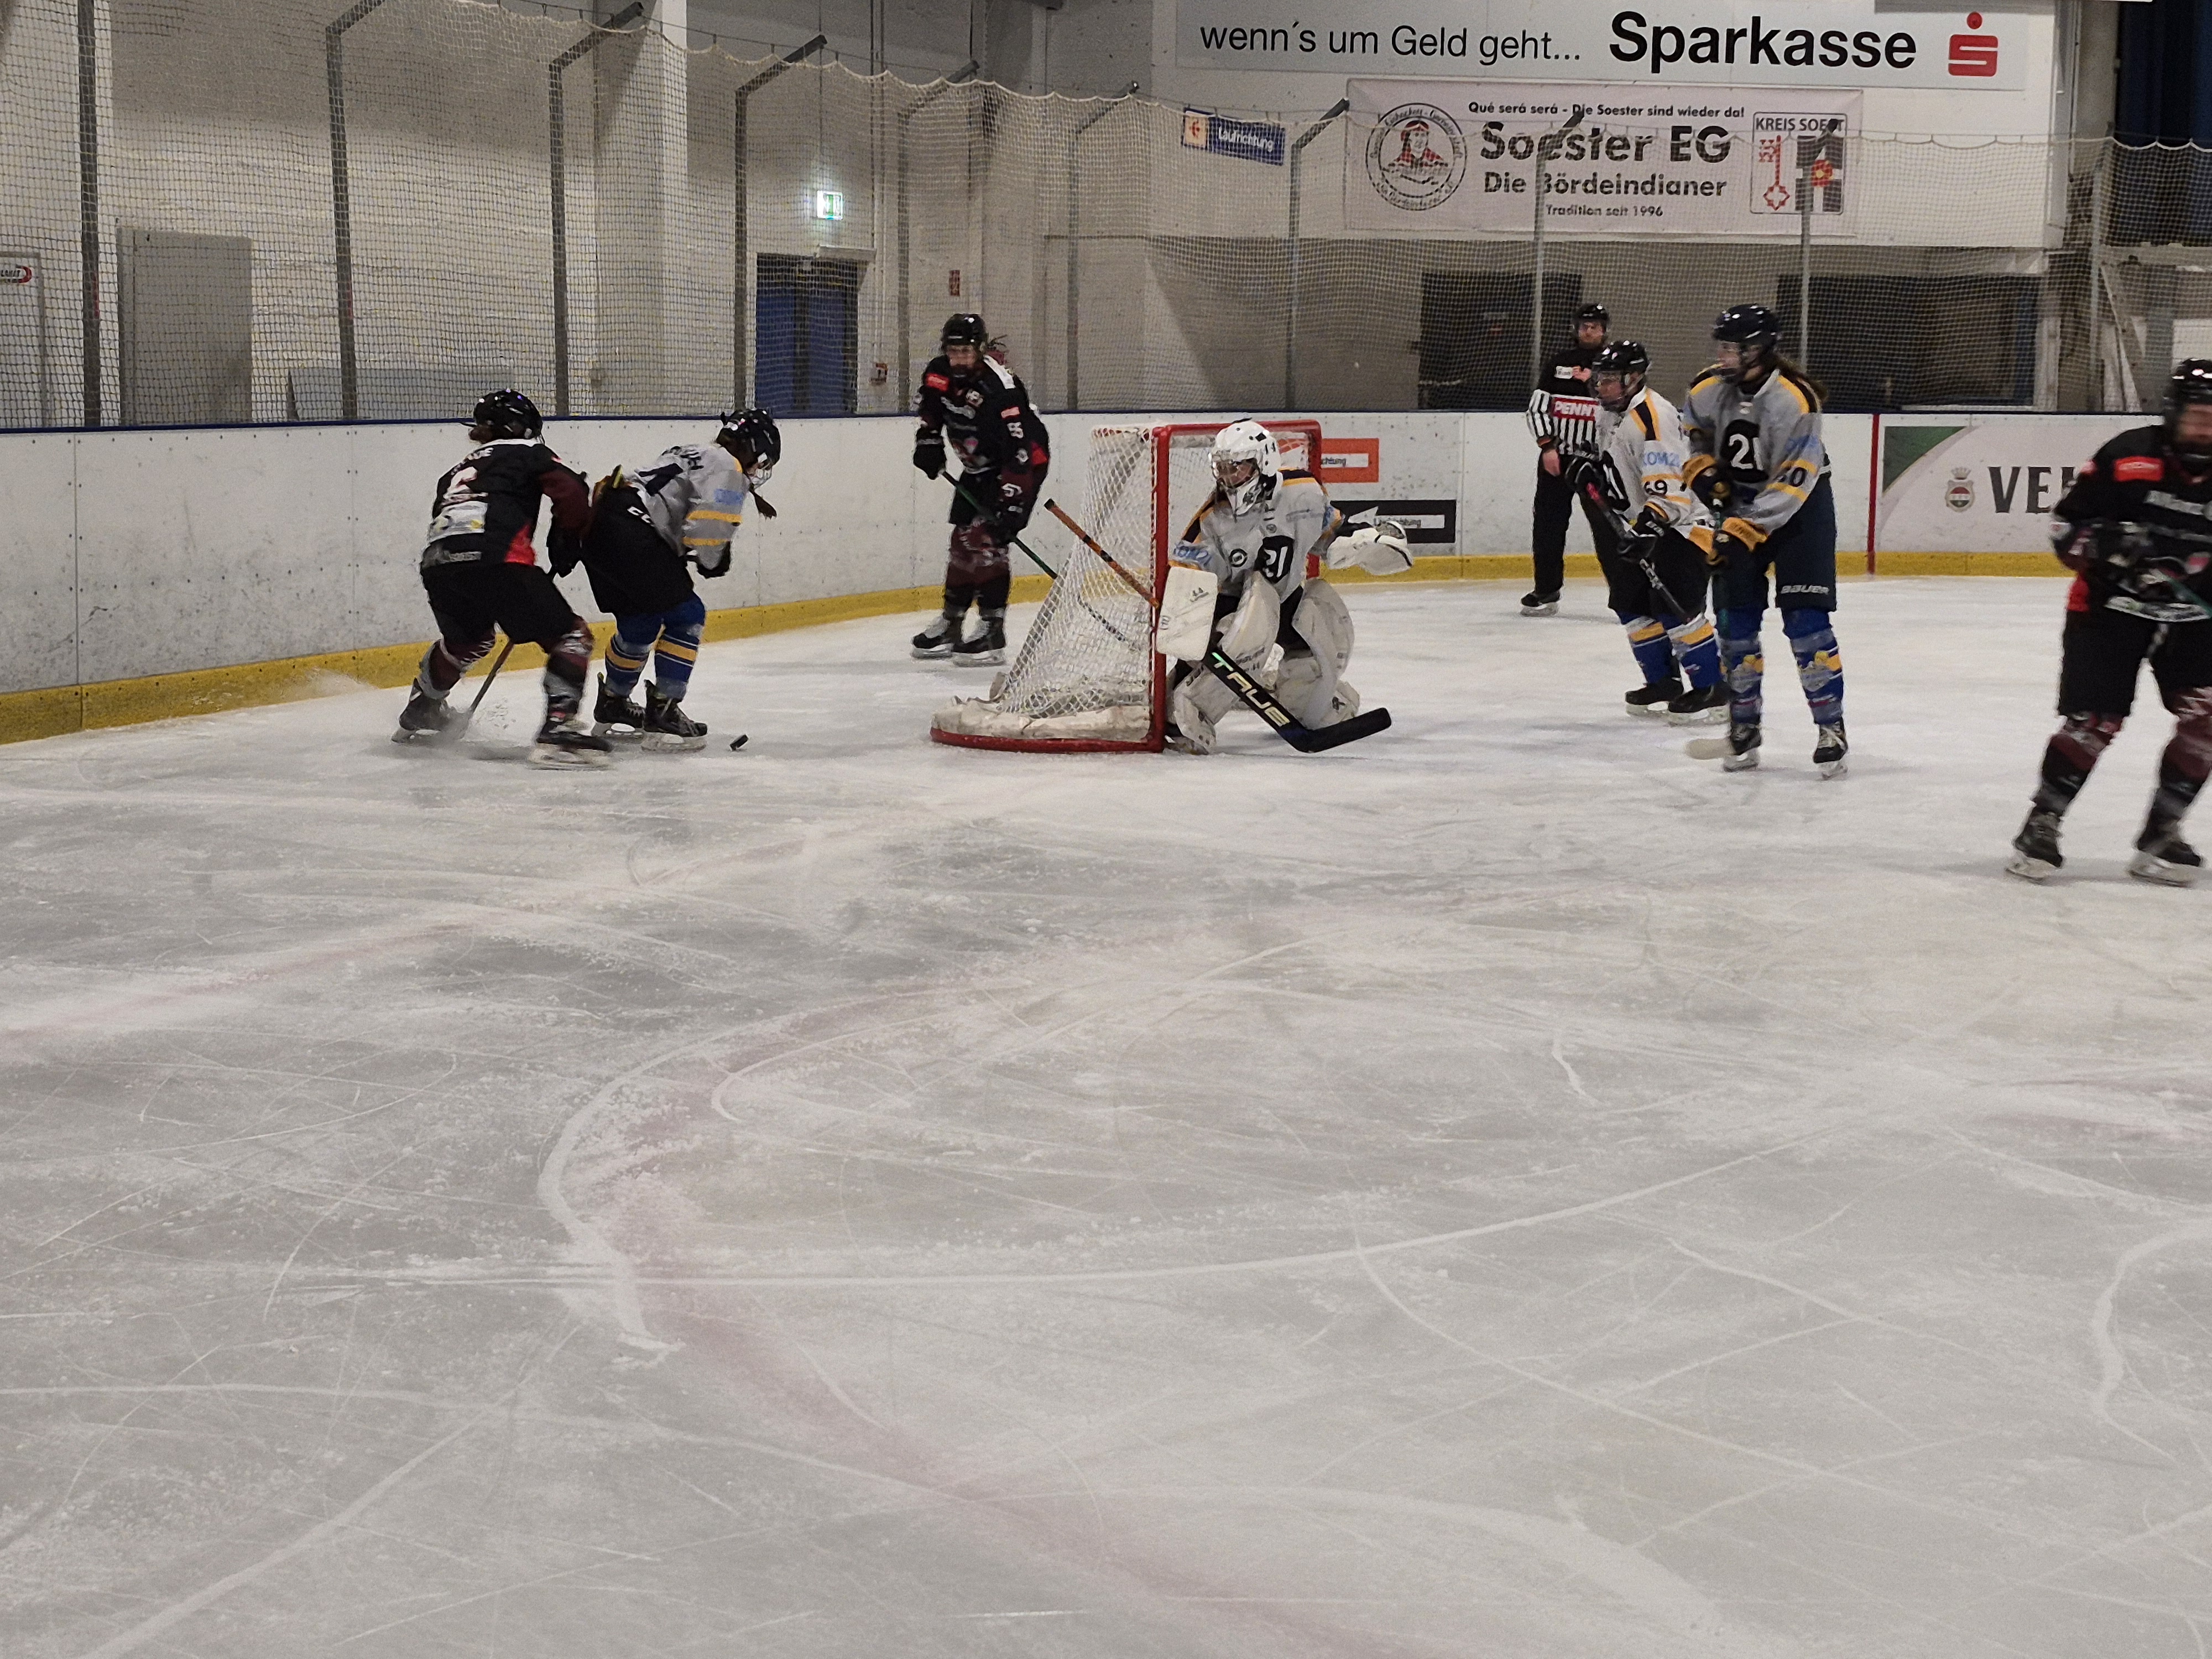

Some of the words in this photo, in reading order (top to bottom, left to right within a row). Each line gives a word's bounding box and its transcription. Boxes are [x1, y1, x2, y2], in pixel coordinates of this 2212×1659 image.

[1329, 29, 1378, 54] um
[1391, 25, 1467, 58] Geld
[1479, 30, 1581, 65] geht...
[1609, 11, 1917, 74] Sparkasse
[1468, 101, 1495, 113] Qué
[1499, 103, 1527, 113] será
[1530, 103, 1558, 114] será
[1597, 105, 1644, 116] Soester
[1647, 105, 1674, 116] sind
[1678, 106, 1721, 117] wieder
[1756, 118, 1796, 131] KREIS
[1799, 118, 1845, 132] SOET
[1670, 126, 1731, 163] EG
[1484, 171, 1527, 192] Die
[1546, 204, 1602, 216] Tradition
[1633, 206, 1663, 217] 1996
[1728, 434, 1765, 471] 21
